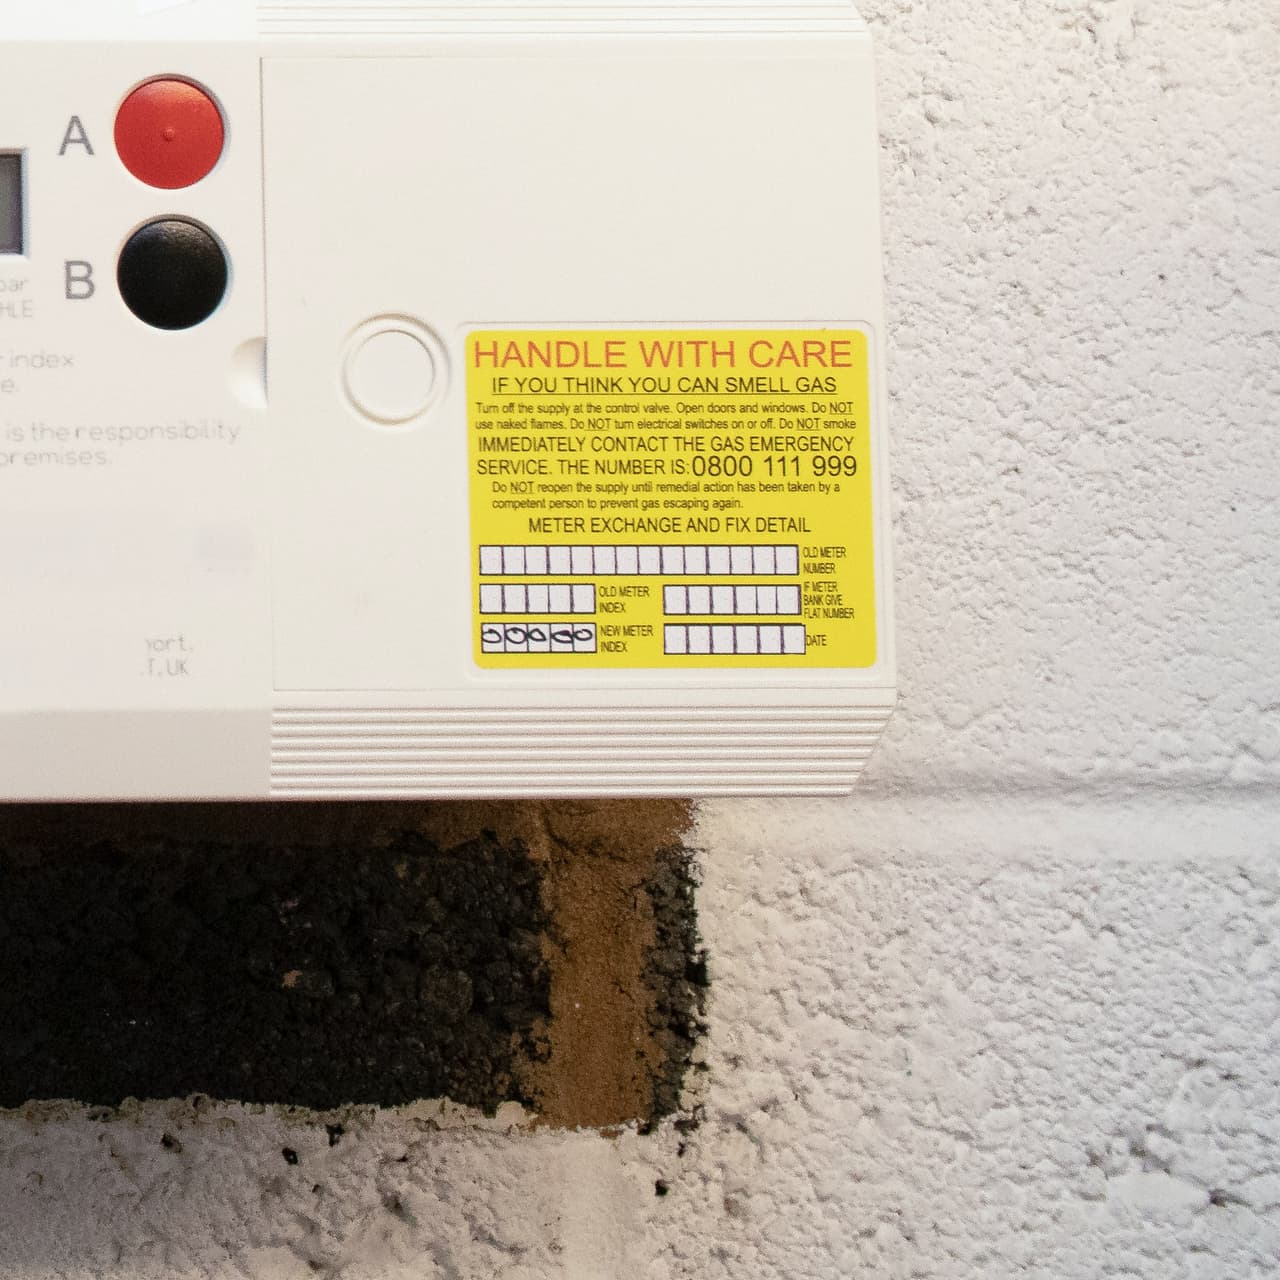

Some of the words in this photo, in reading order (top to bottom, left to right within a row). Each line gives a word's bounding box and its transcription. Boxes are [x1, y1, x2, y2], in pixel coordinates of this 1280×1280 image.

[58, 116, 94, 155] A
[64, 261, 95, 299] B
[9, 350, 74, 369] index
[475, 341, 627, 368] HANDLE
[639, 341, 735, 368] WITH
[749, 340, 852, 368] CARE
[493, 377, 508, 392] IF
[515, 377, 556, 392] YOU
[563, 377, 622, 392] THINK
[629, 377, 670, 392] YOU
[678, 377, 718, 392] CAN
[726, 377, 789, 392] SMELL
[796, 377, 836, 392] GAS
[476, 402, 499, 413] Turn
[502, 402, 515, 413] off
[518, 403, 534, 413] the
[537, 403, 570, 416] supply
[586, 402, 602, 413] the
[605, 403, 640, 413] control
[676, 402, 704, 415] Open
[707, 402, 736, 413] doors
[739, 403, 758, 413] and
[812, 402, 826, 413] Do
[829, 402, 853, 415] NOT
[476, 421, 493, 429] use
[497, 419, 527, 429] naked
[571, 418, 584, 429] Do
[588, 418, 611, 429] NOT
[615, 420, 633, 429] turn
[637, 419, 681, 429] electrical
[685, 419, 728, 429] switches
[779, 418, 793, 429] Do
[797, 418, 820, 430] NOT
[823, 419, 856, 429] smoke
[30, 422, 71, 441] the
[74, 421, 240, 445] responsibility
[479, 437, 585, 452] IMMEDIATELY
[591, 436, 669, 452] CONTACT
[673, 436, 705, 451] THE
[711, 436, 744, 452] GAS
[750, 436, 854, 451] EMERGENCY
[477, 459, 552, 475] SERVICE.
[557, 459, 589, 475] THE
[595, 459, 665, 474] NUMBER
[671, 459, 689, 474] IS:
[692, 455, 752, 476] 0800
[764, 455, 799, 476] 111
[812, 455, 856, 476] 999
[492, 481, 507, 493] Do
[510, 481, 534, 494] NOT
[537, 484, 573, 494] reopen
[576, 482, 592, 492] the
[595, 482, 629, 495] supply
[632, 481, 653, 492] until
[656, 481, 700, 492] remedial
[703, 481, 734, 492] action
[737, 481, 756, 492] has
[758, 481, 784, 492] been
[787, 481, 815, 492] taken
[492, 498, 546, 511] competent
[549, 500, 584, 509] person
[600, 498, 638, 511] prevent
[641, 500, 660, 511] gas
[663, 497, 709, 511] escaping
[529, 517, 585, 533] METER
[591, 517, 682, 533] EXCHANGE
[686, 517, 720, 532] AND
[726, 517, 751, 532] FIX
[756, 517, 811, 532] DETAIL
[802, 547, 818, 558] OLD
[820, 547, 846, 558] METER
[803, 563, 836, 574] NUMBER
[599, 586, 617, 597] OLD
[619, 586, 649, 597] METER
[804, 582, 810, 592] IF
[812, 581, 838, 593] METER
[599, 602, 626, 613] INDEX
[804, 595, 824, 606] BANK
[825, 595, 843, 606] GIVE
[804, 608, 821, 619] FLAT
[822, 608, 855, 619] NUMBER
[601, 625, 621, 636] NEW
[623, 625, 653, 636] METER
[601, 641, 627, 652] INDEX
[806, 635, 827, 646] DATE
